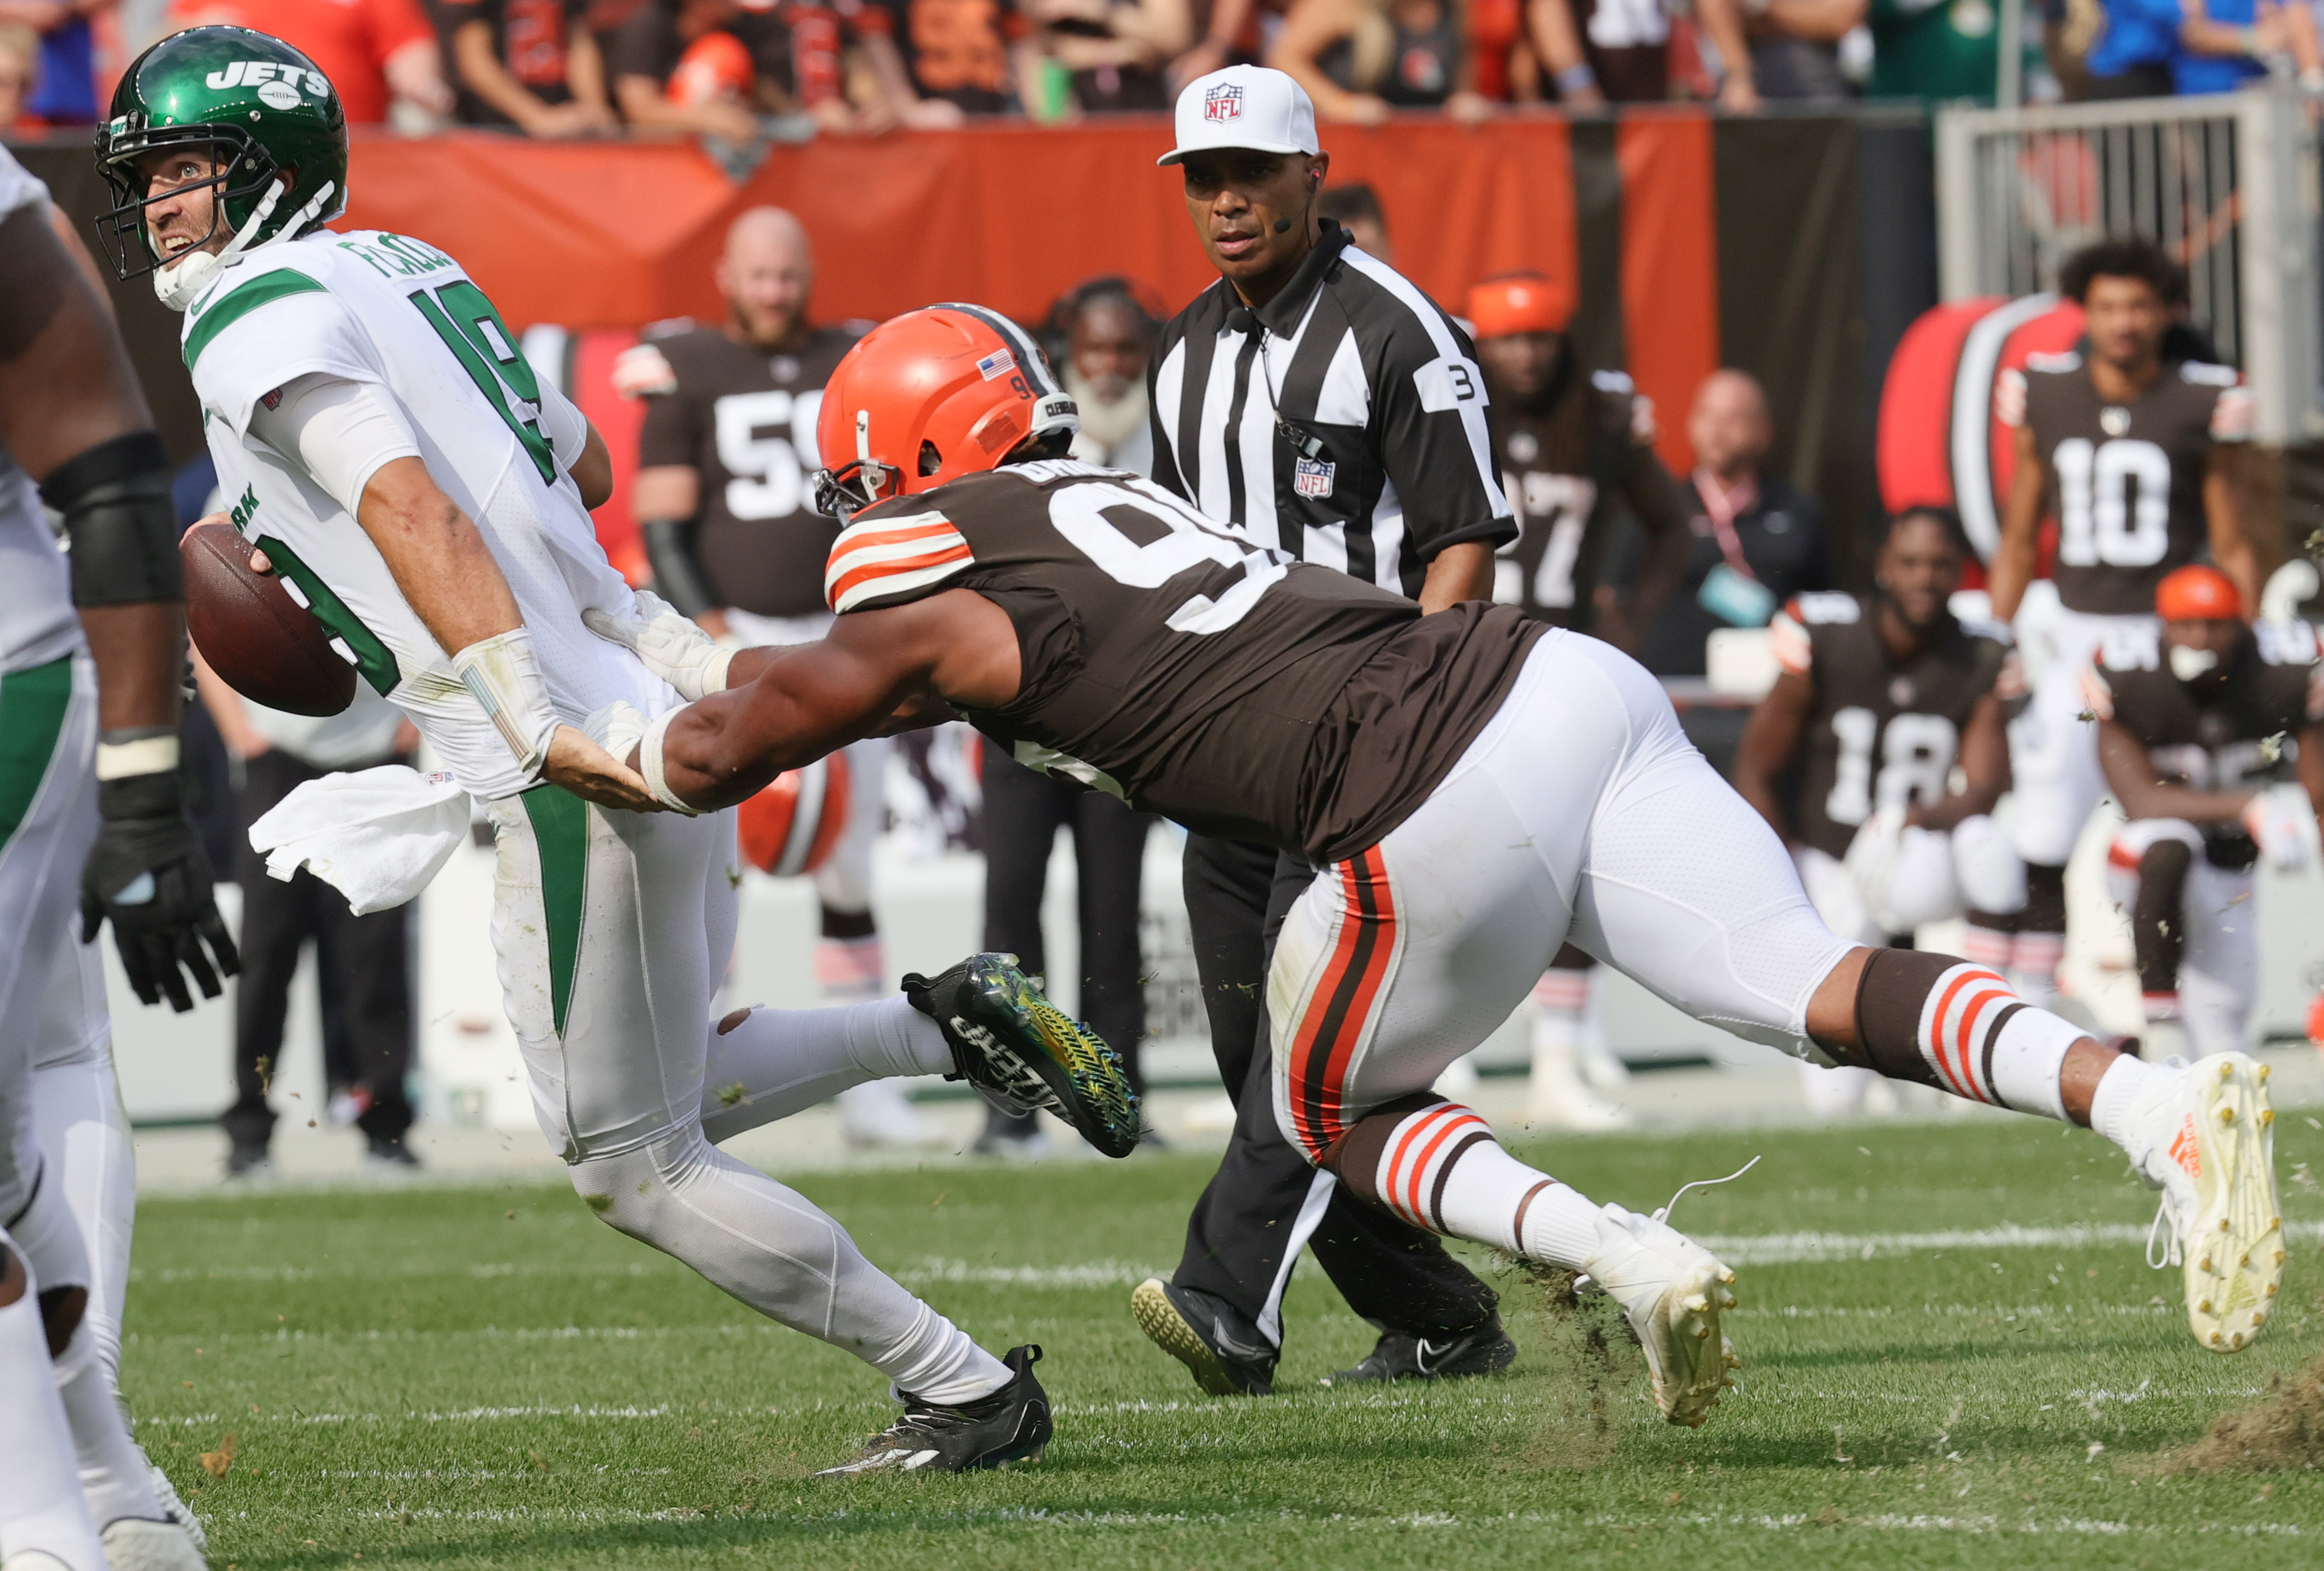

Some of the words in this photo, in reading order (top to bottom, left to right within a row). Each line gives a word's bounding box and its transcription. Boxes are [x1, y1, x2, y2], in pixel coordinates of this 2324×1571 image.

[206, 61, 329, 98] JETS
[1206, 99, 1239, 120] NFL
[407, 279, 558, 487] 19
[1448, 364, 1475, 401] 3
[1299, 474, 1328, 494] NFL
[2052, 437, 2171, 566] 10
[1825, 706, 1959, 826] 18
[2184, 1111, 2203, 1179] adidas
